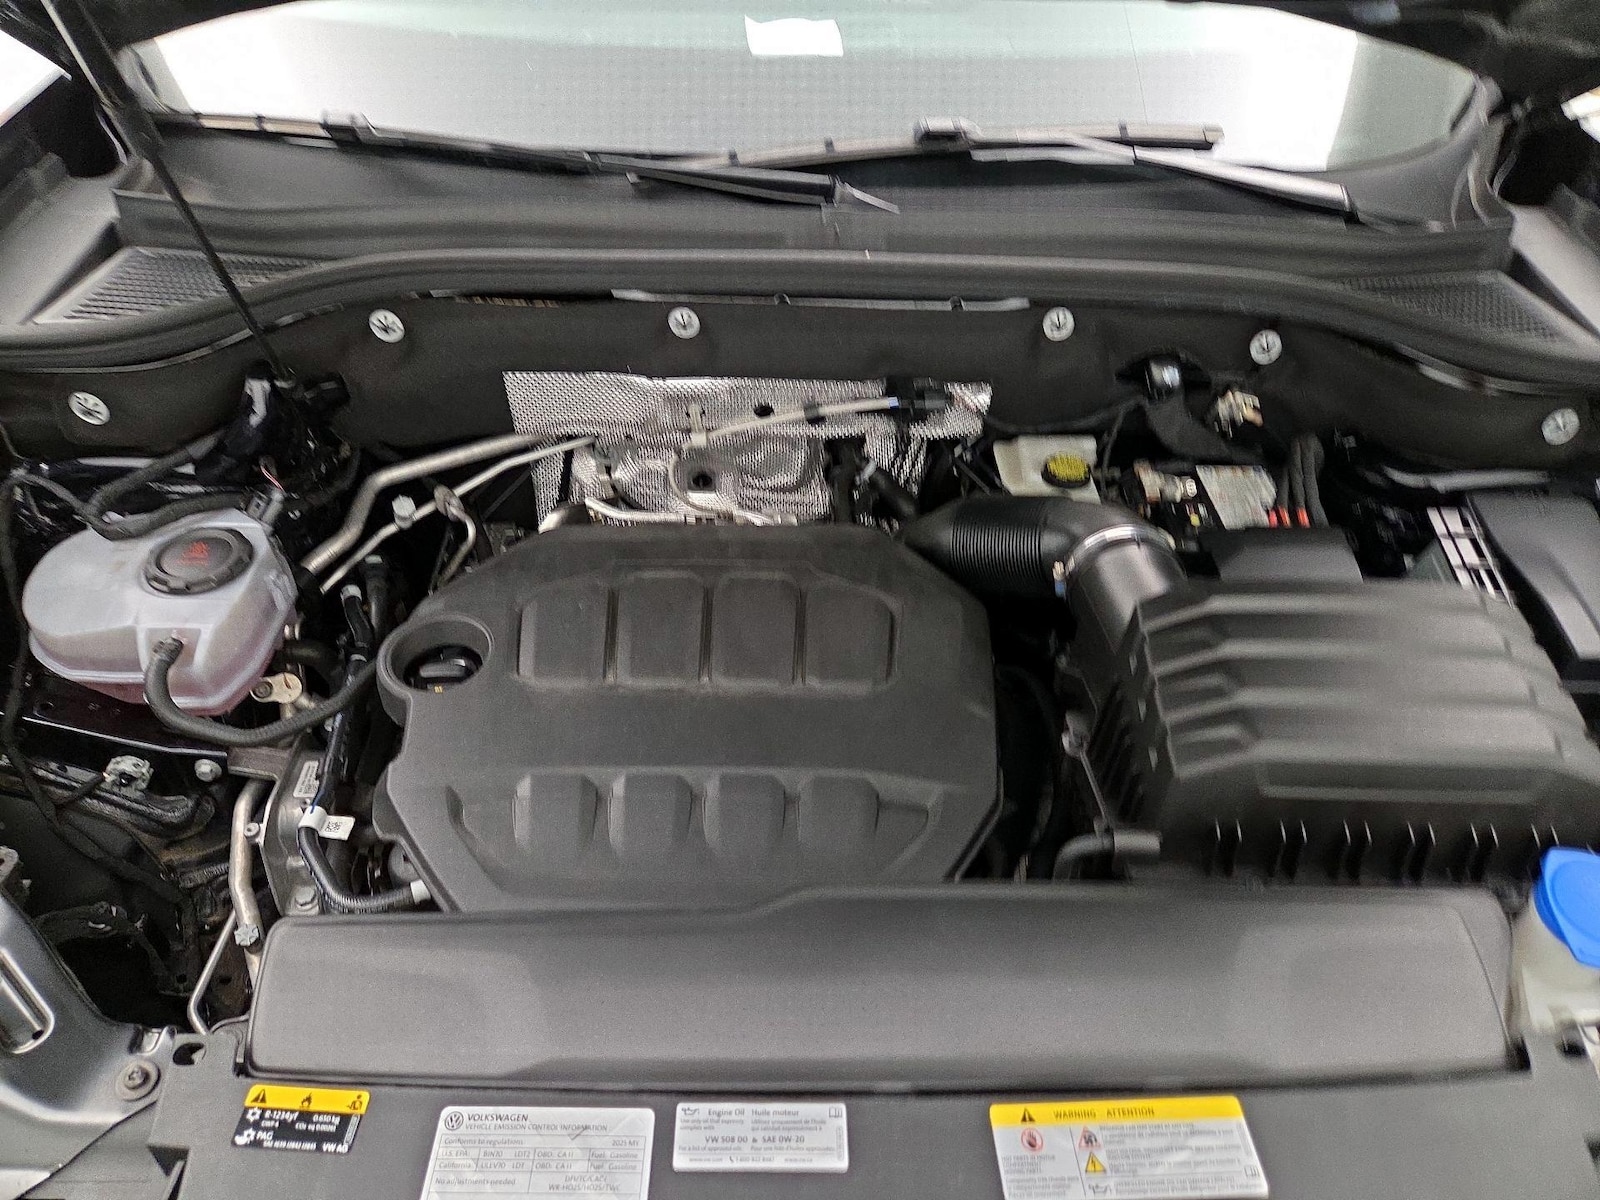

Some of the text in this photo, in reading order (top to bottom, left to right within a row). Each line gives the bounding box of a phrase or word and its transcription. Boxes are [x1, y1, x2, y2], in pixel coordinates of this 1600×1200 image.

[264, 1110, 299, 1122] R-1234yf
[467, 1113, 528, 1122] VOLKSWAGEN
[708, 1108, 744, 1118] Engine Oil
[1052, 1107, 1154, 1119] WARNING ATTENTION
[256, 1131, 274, 1140] PAG
[485, 1138, 524, 1148] regulations
[322, 1143, 349, 1154] VW AG
[447, 1178, 488, 1186] adjustments
[490, 1178, 516, 1186] needed
